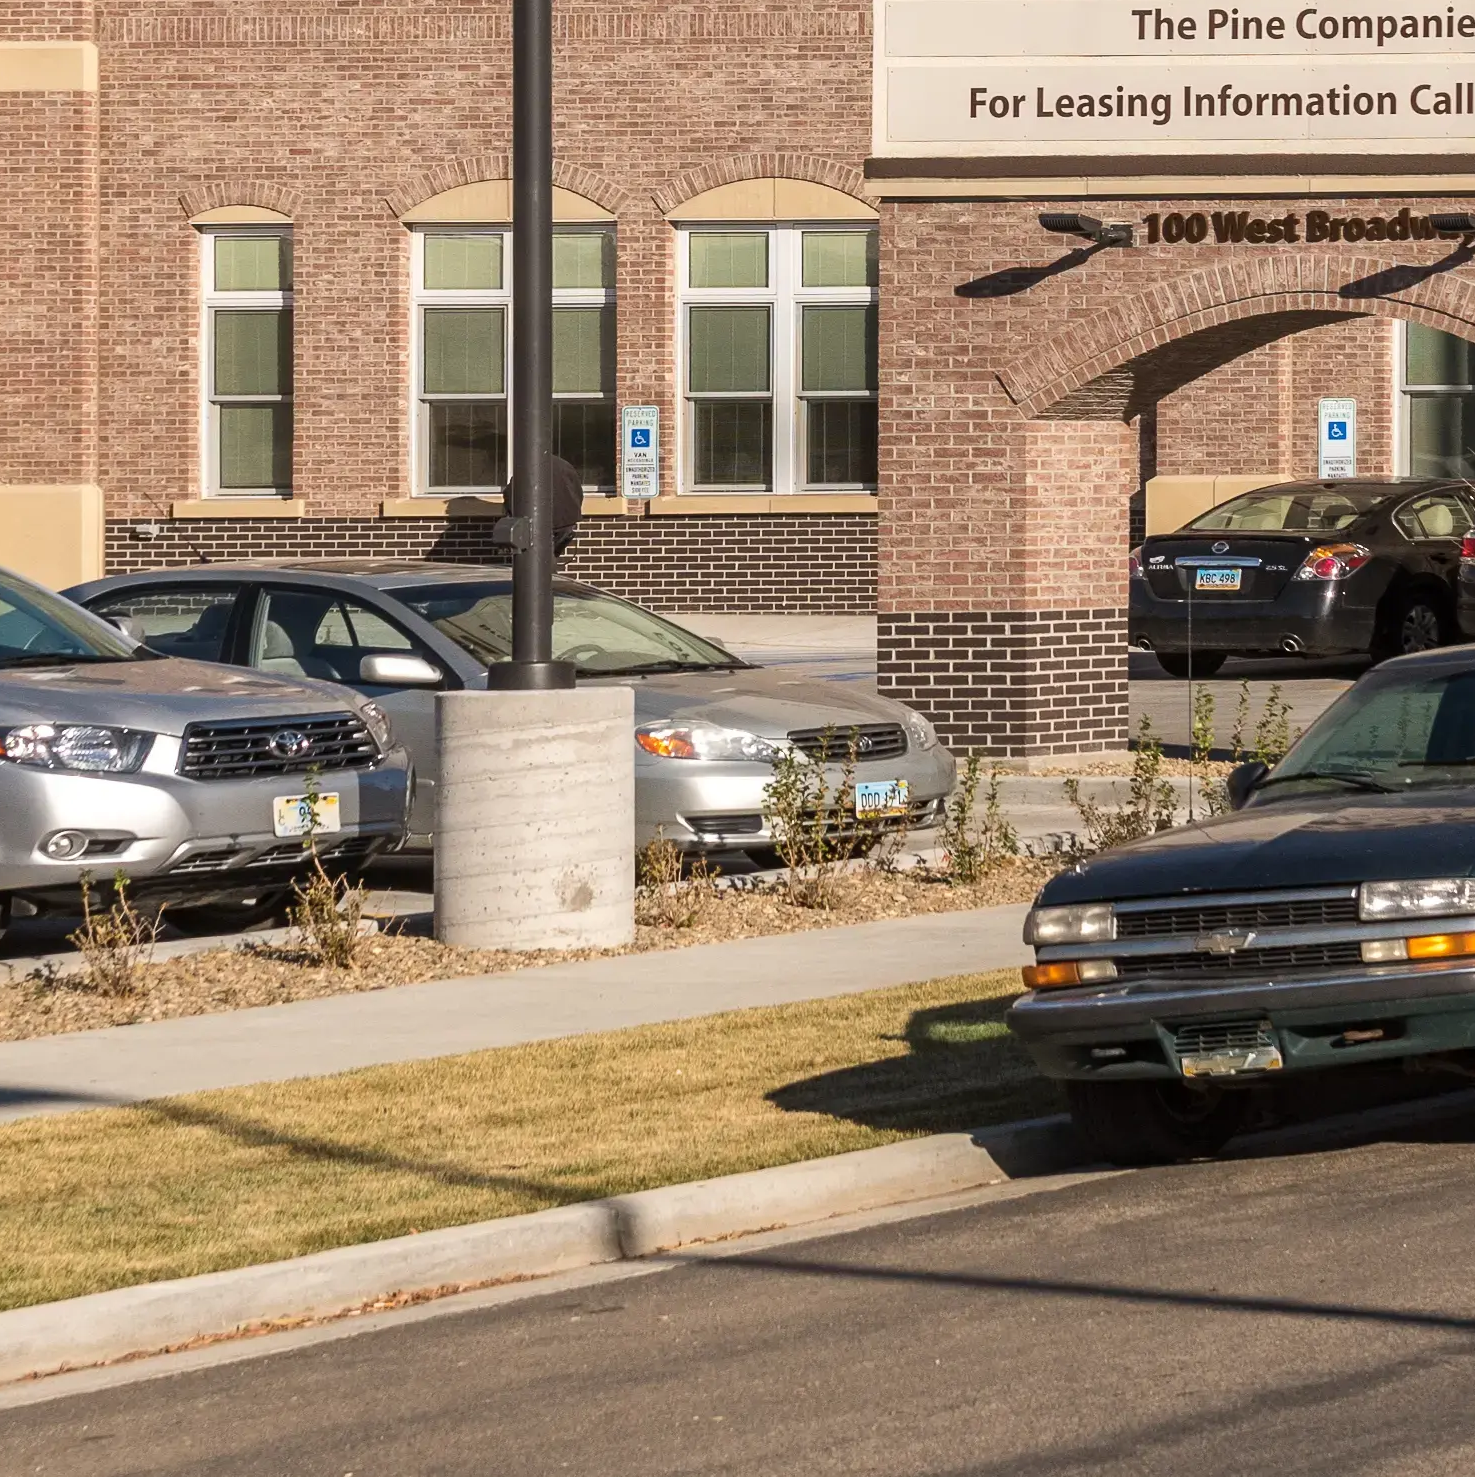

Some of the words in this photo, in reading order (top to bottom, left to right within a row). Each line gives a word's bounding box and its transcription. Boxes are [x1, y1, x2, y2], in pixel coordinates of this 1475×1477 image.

[1131, 8, 1197, 40] The
[1208, 7, 1286, 40] Pine
[970, 87, 1026, 119] For
[1036, 85, 1172, 126] Leasing
[1184, 83, 1397, 117] Information
[1410, 82, 1474, 115] Call
[1143, 212, 1210, 244] 100
[1213, 211, 1302, 244] West
[626, 410, 656, 418] RESERVED
[627, 419, 654, 427] PARKING
[1199, 574, 1216, 583] KBC
[1219, 573, 1236, 583] 498
